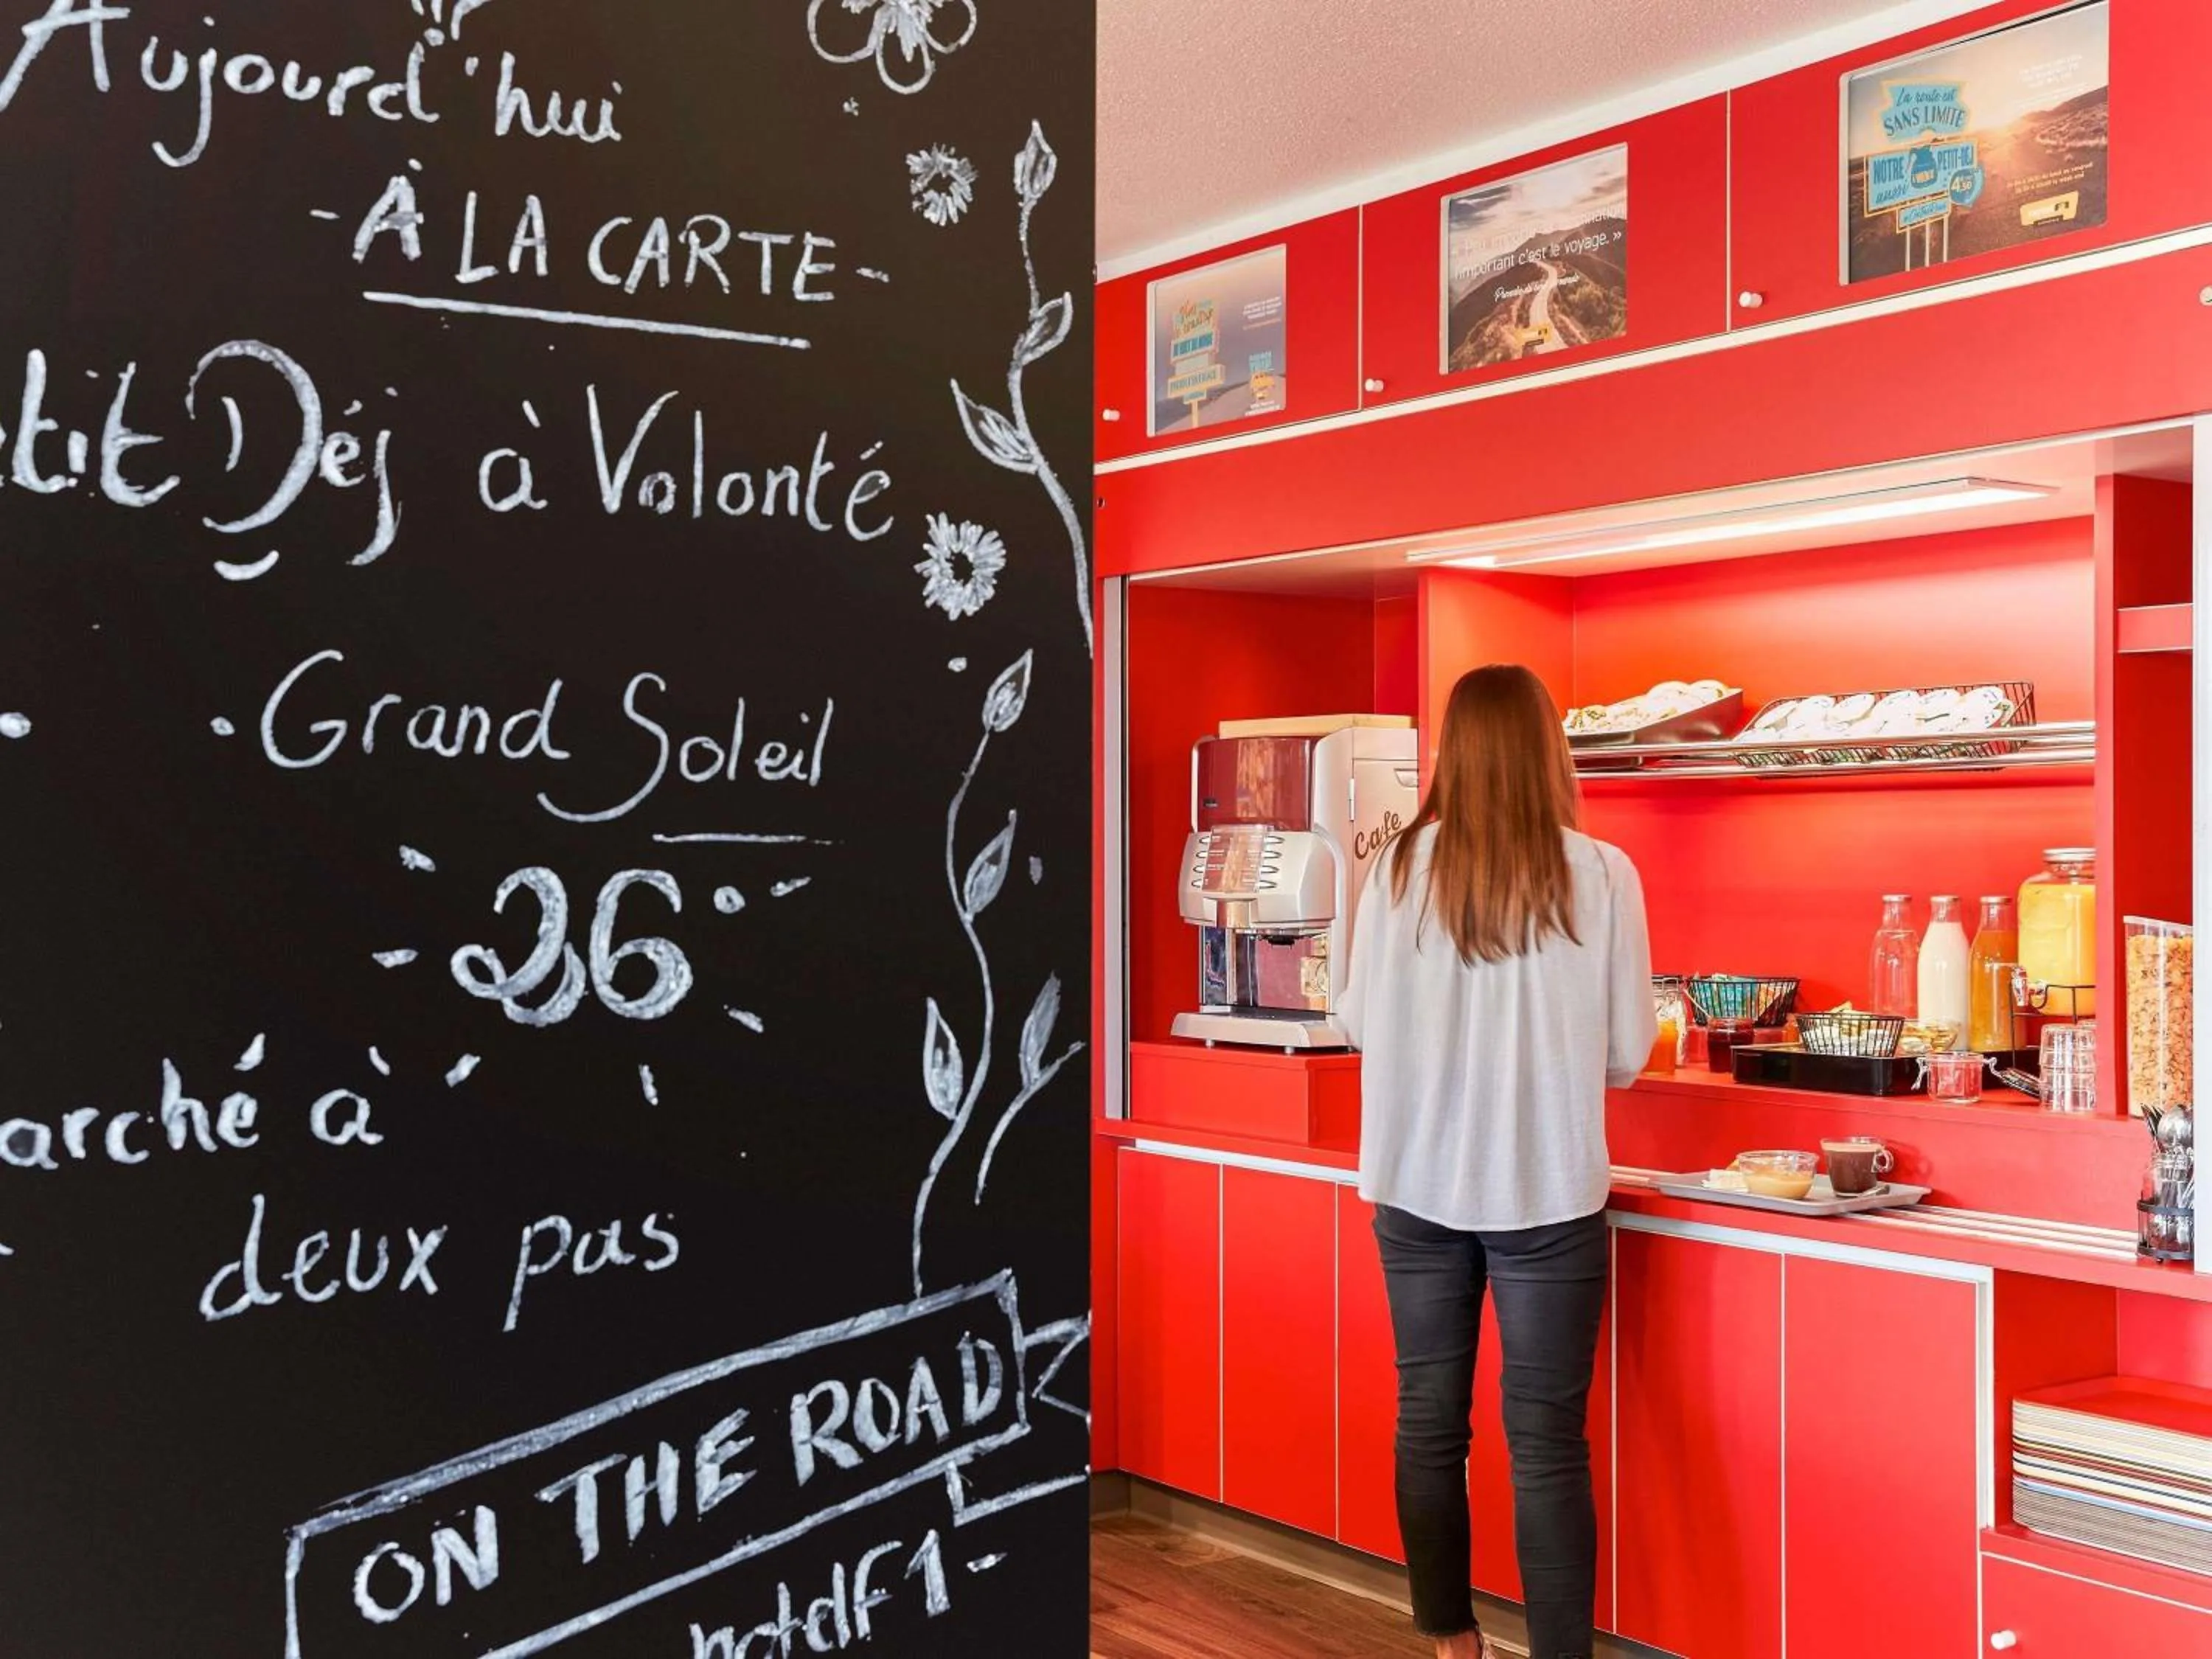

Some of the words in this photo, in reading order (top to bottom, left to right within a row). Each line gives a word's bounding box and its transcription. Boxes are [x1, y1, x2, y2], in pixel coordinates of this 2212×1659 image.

[1884, 107, 1919, 136] SANS
[1924, 105, 1966, 128] LIMITE
[455, 191, 548, 283] LA
[588, 215, 835, 301] CARTE
[1518, 246, 1547, 265] c'est
[1549, 244, 1560, 257] le
[0, 349, 180, 507] tit
[186, 340, 400, 565] Déj
[479, 400, 547, 512] à
[587, 384, 894, 541] Volonté
[261, 650, 570, 768] Grand
[538, 672, 833, 822] Soleil
[311, 1046, 389, 1144] à
[200, 1194, 447, 1321] deux
[504, 1212, 680, 1332] pas
[353, 1505, 498, 1623] ON
[535, 1408, 757, 1563] THE
[789, 1332, 1004, 1486] ROAD
